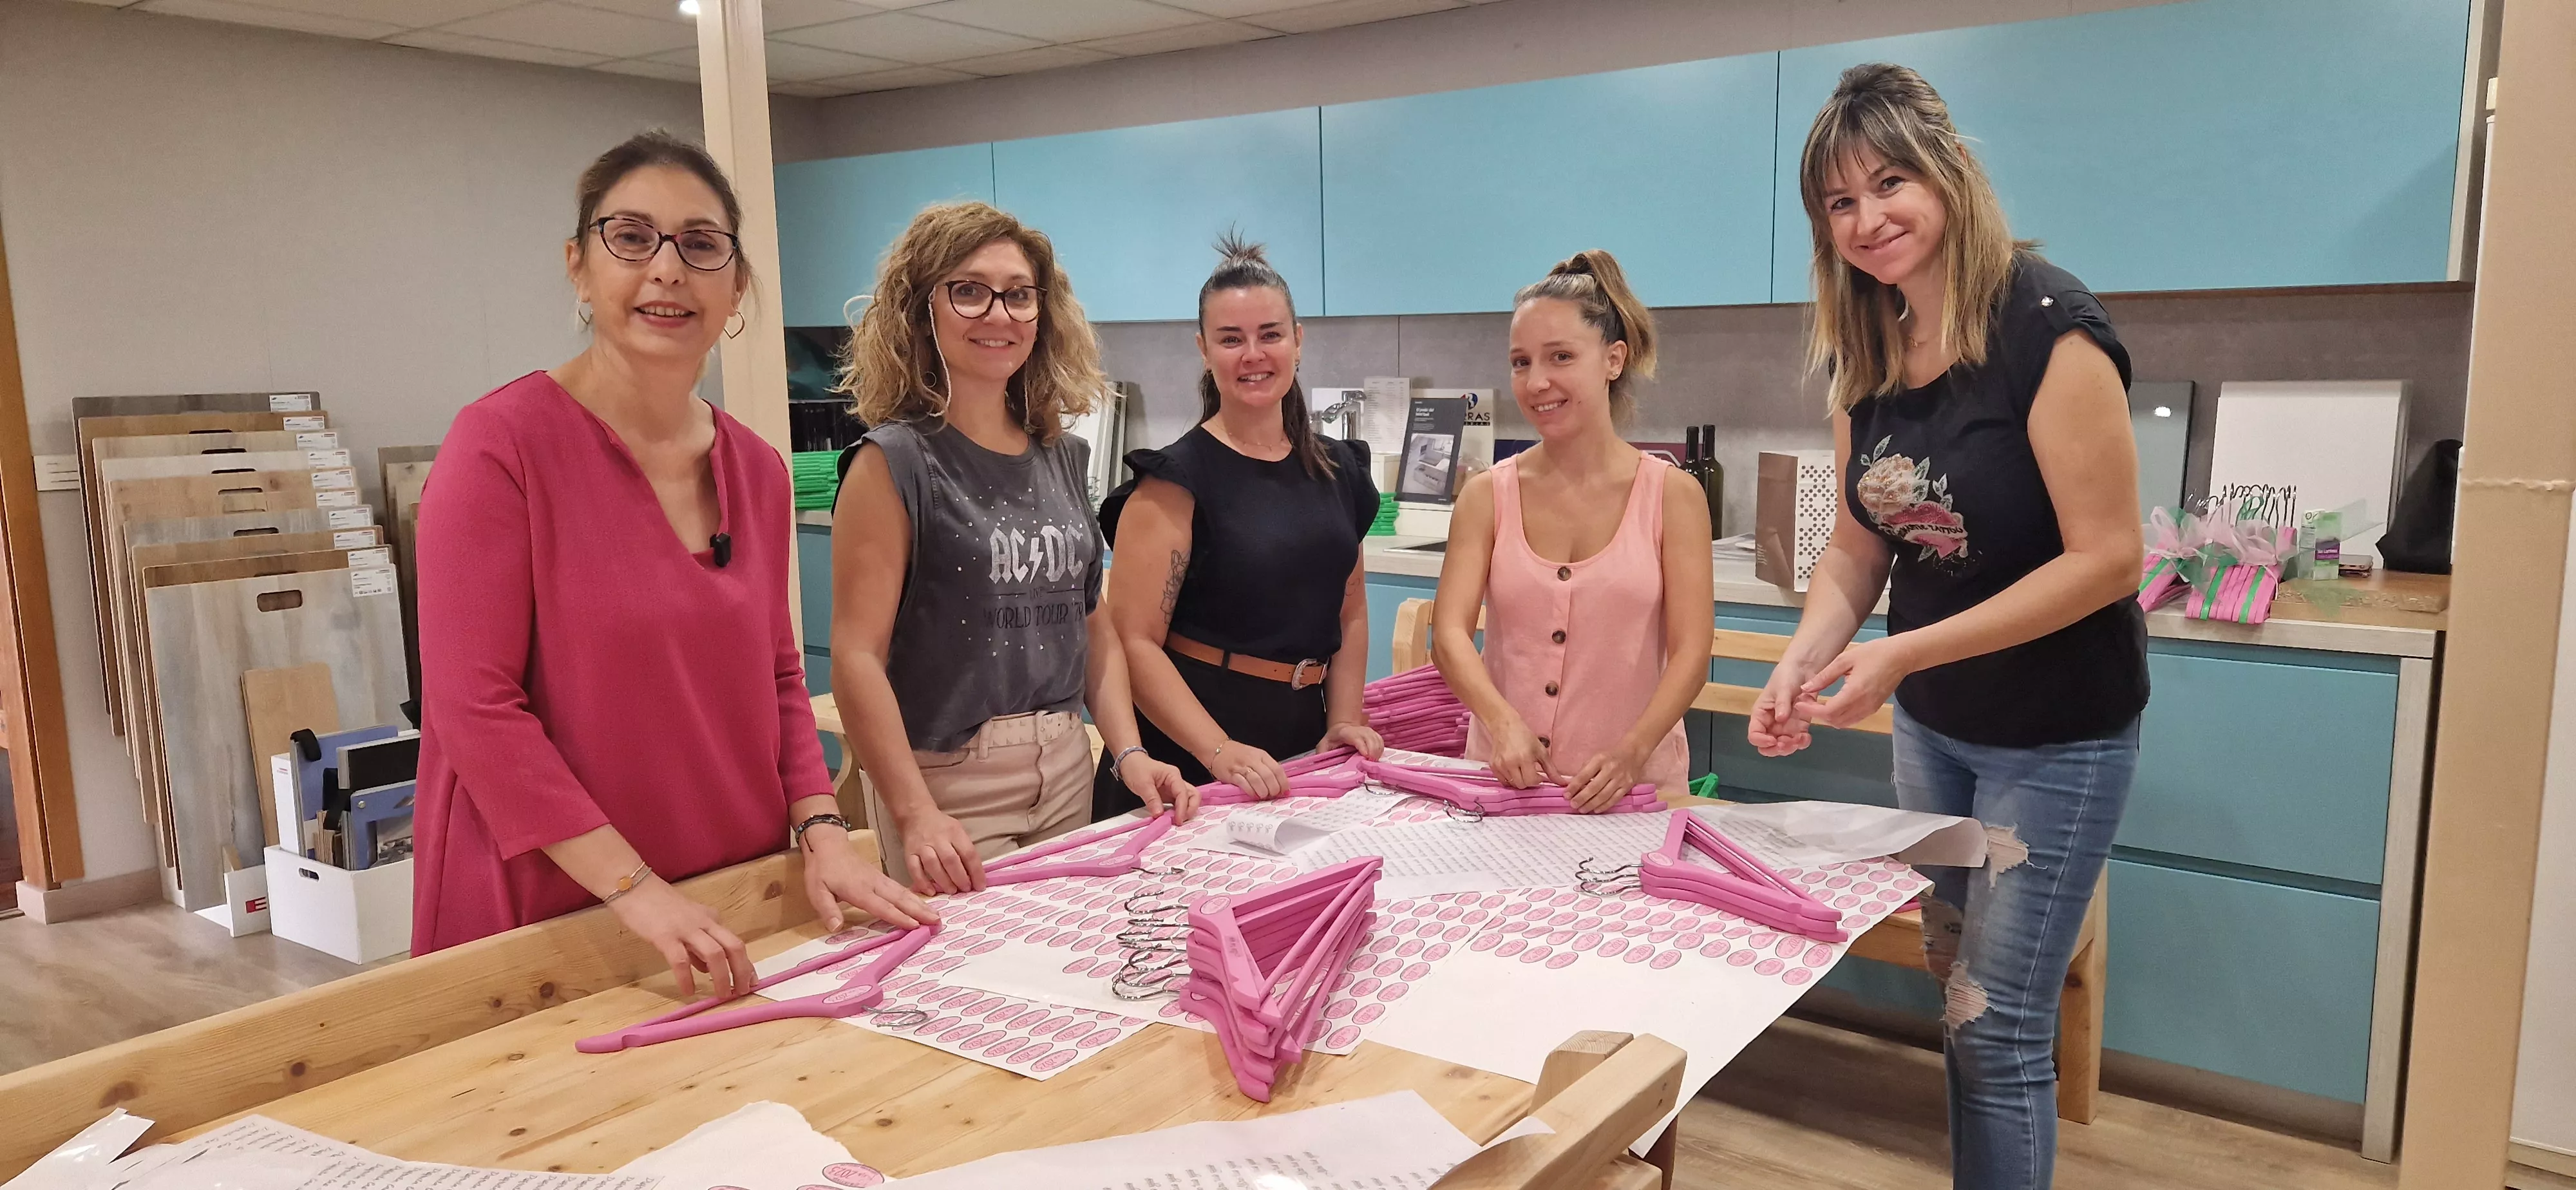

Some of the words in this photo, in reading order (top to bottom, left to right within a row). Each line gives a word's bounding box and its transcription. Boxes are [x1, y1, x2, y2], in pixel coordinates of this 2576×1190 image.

[984, 606, 1030, 629] WORLD
[1036, 603, 1069, 627] TOUR
[829, 1166, 857, 1179] 2023
